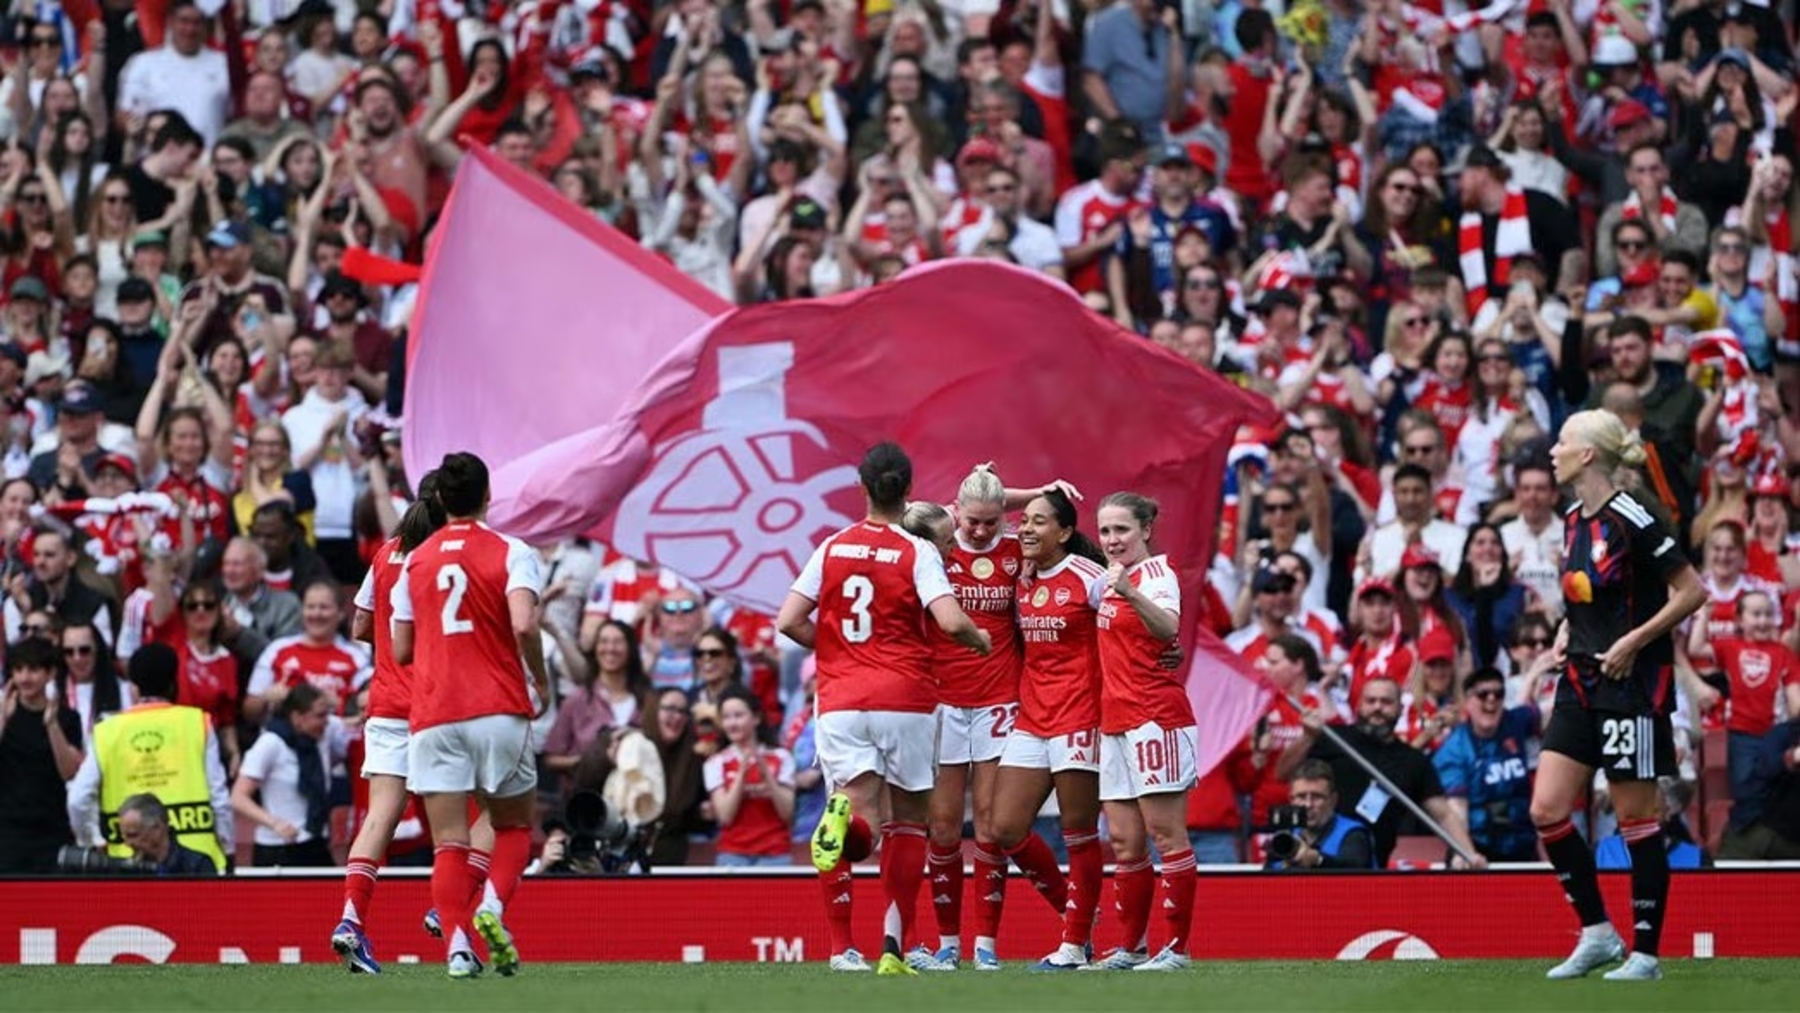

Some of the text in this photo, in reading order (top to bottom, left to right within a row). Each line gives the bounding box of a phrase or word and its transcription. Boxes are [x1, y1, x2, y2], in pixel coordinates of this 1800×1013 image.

[437, 563, 474, 635] 2
[842, 574, 874, 643] 3
[1019, 613, 1067, 629] mirates
[1602, 719, 1636, 755] 23
[1135, 738, 1163, 773] 10
[1485, 757, 1526, 785] JVC
[107, 805, 215, 840] SARD
[751, 936, 804, 962] TM
